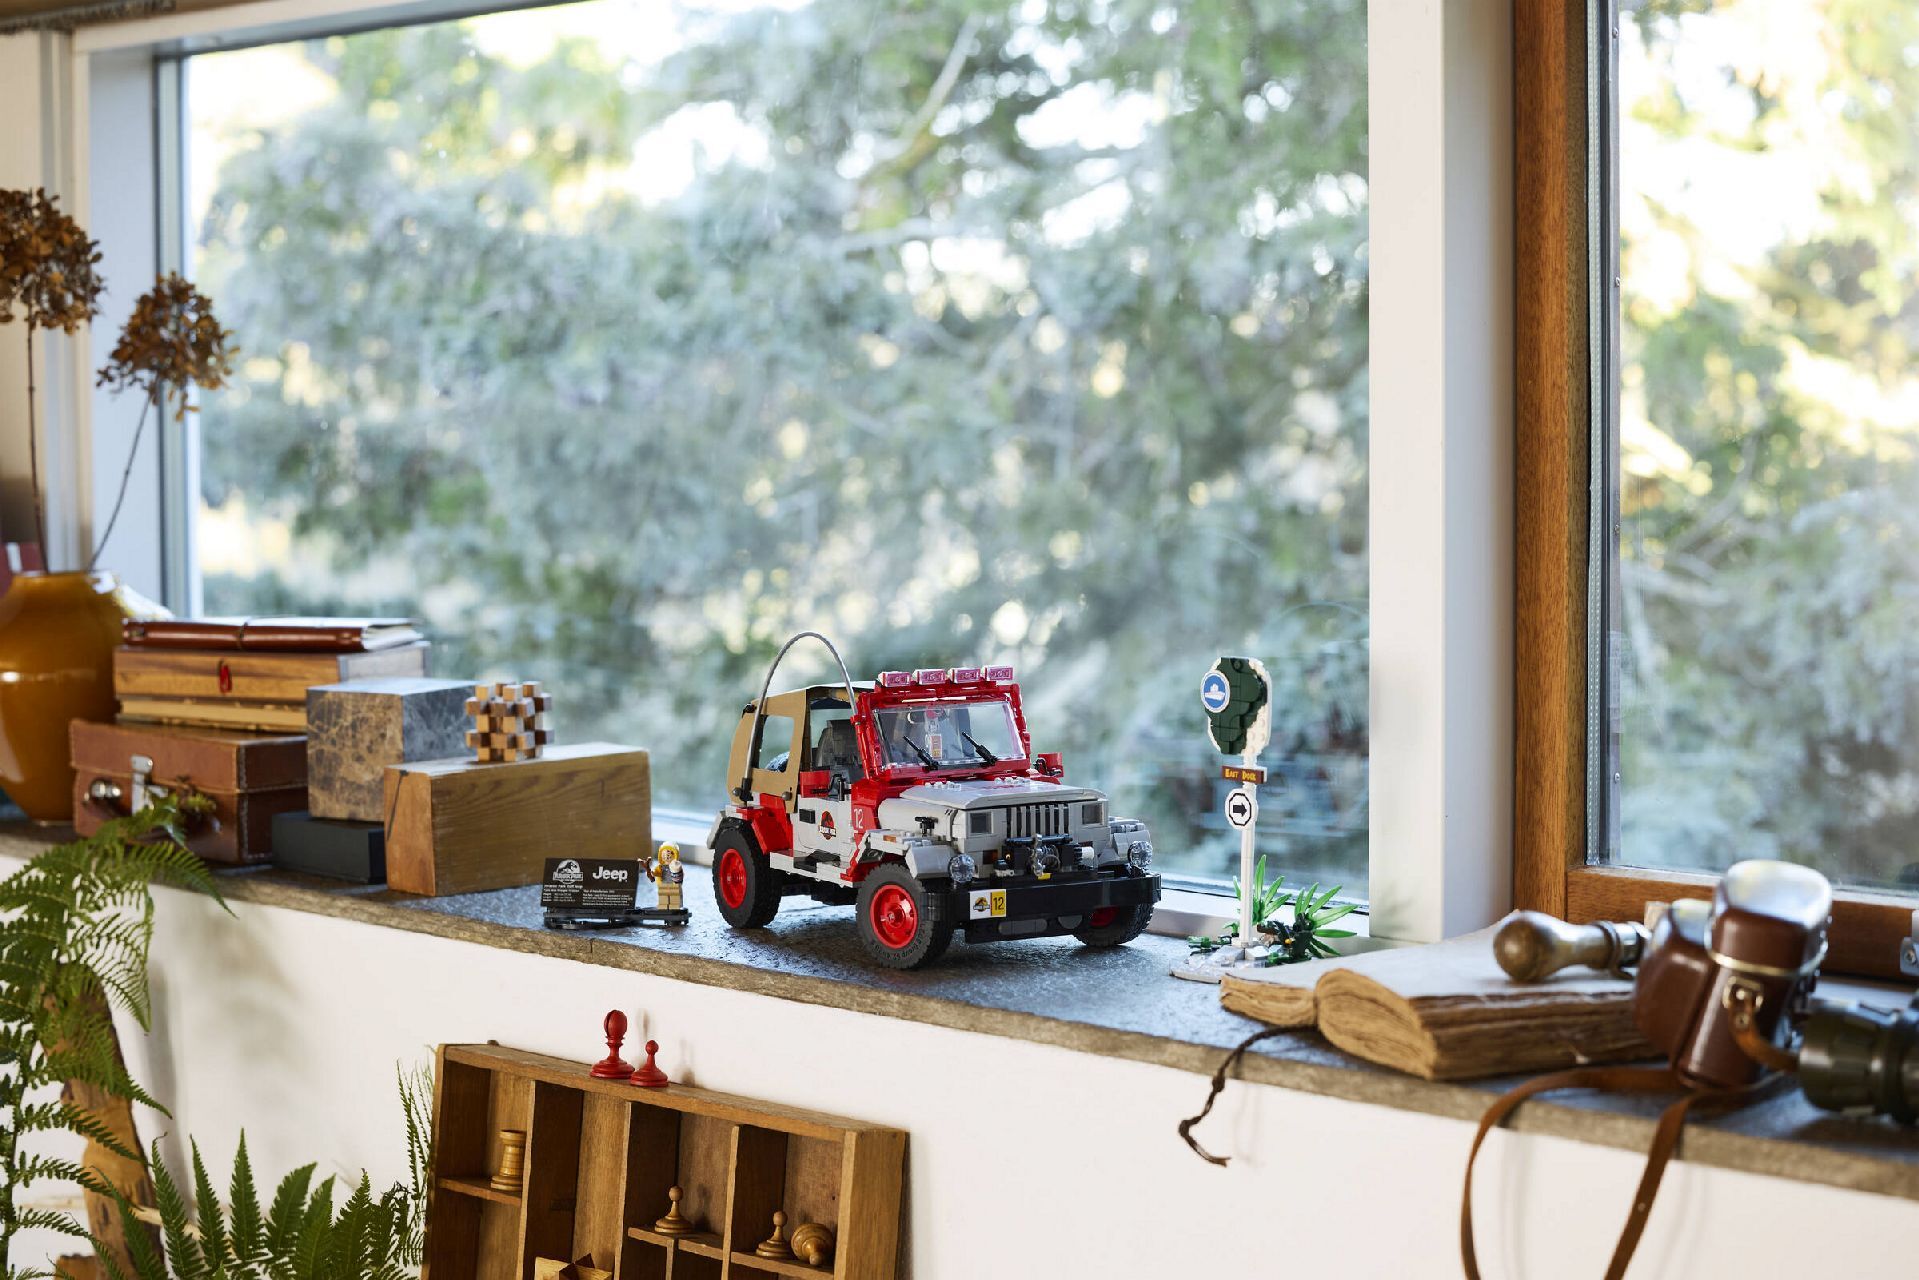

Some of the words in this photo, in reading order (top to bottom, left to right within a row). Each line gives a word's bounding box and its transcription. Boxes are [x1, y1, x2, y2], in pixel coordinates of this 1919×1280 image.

[853, 808, 864, 829] 12
[592, 866, 628, 882] Jeep
[993, 896, 1005, 911] 12
